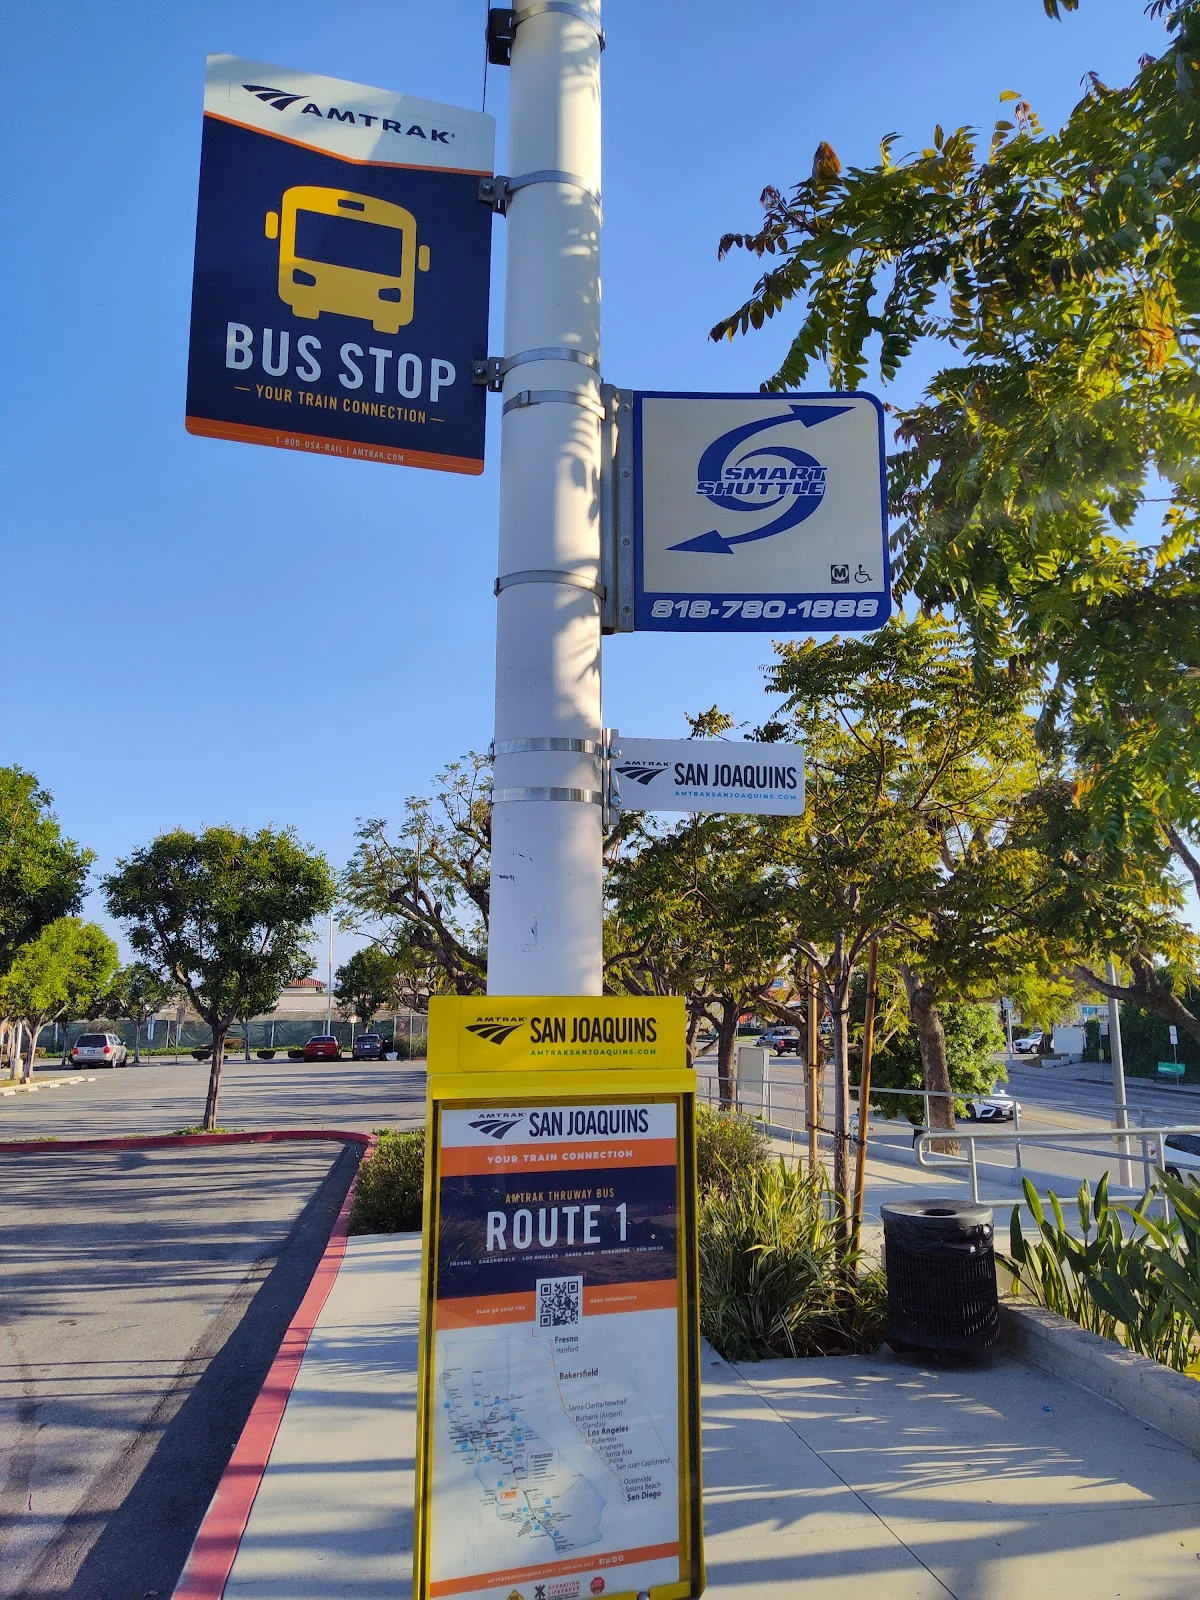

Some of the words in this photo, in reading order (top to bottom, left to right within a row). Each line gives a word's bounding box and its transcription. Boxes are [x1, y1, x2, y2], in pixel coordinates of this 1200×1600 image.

[225, 321, 322, 383] BUS
[338, 342, 456, 403] STOP
[256, 384, 293, 403] YOUR
[299, 391, 338, 410] TRAIN
[343, 398, 427, 424] CONNECTION
[275, 436, 343, 454] 1-800-USA-RAIL
[352, 448, 404, 463] AMTRAK.COM
[724, 467, 827, 480] SMART
[696, 481, 825, 495] SHUTTLE
[651, 599, 879, 619] 818-780-1888
[674, 762, 708, 786] SAN
[712, 764, 798, 790] JOAQUINS
[674, 791, 797, 801] AMTRAKSANJOAQUINS.COM
[530, 1017, 566, 1044] SAN
[571, 1017, 657, 1044] JOAQUINS
[530, 1048, 657, 1057] AMTRAKSANJOAQUINS.COM
[529, 1111, 564, 1138] SAN
[567, 1109, 649, 1137] JOAQUINS
[487, 1155, 519, 1165] YOUR
[523, 1153, 558, 1163] TRAIN
[562, 1150, 634, 1161] CONNECTION
[505, 1193, 545, 1205] AMTRAK
[548, 1190, 593, 1202] THRUWAY
[597, 1188, 615, 1199] BUS
[487, 1204, 601, 1252] ROUTE
[616, 1202, 628, 1242] 1
[554, 1336, 579, 1344] Fresno
[559, 1368, 599, 1380] Bakersfield
[568, 1404, 584, 1412] Santa
[587, 1429, 600, 1437] Los
[601, 1425, 629, 1436] Angeles
[644, 1481, 662, 1490] Beach
[627, 1493, 640, 1502] San
[641, 1490, 662, 1500] Diego
